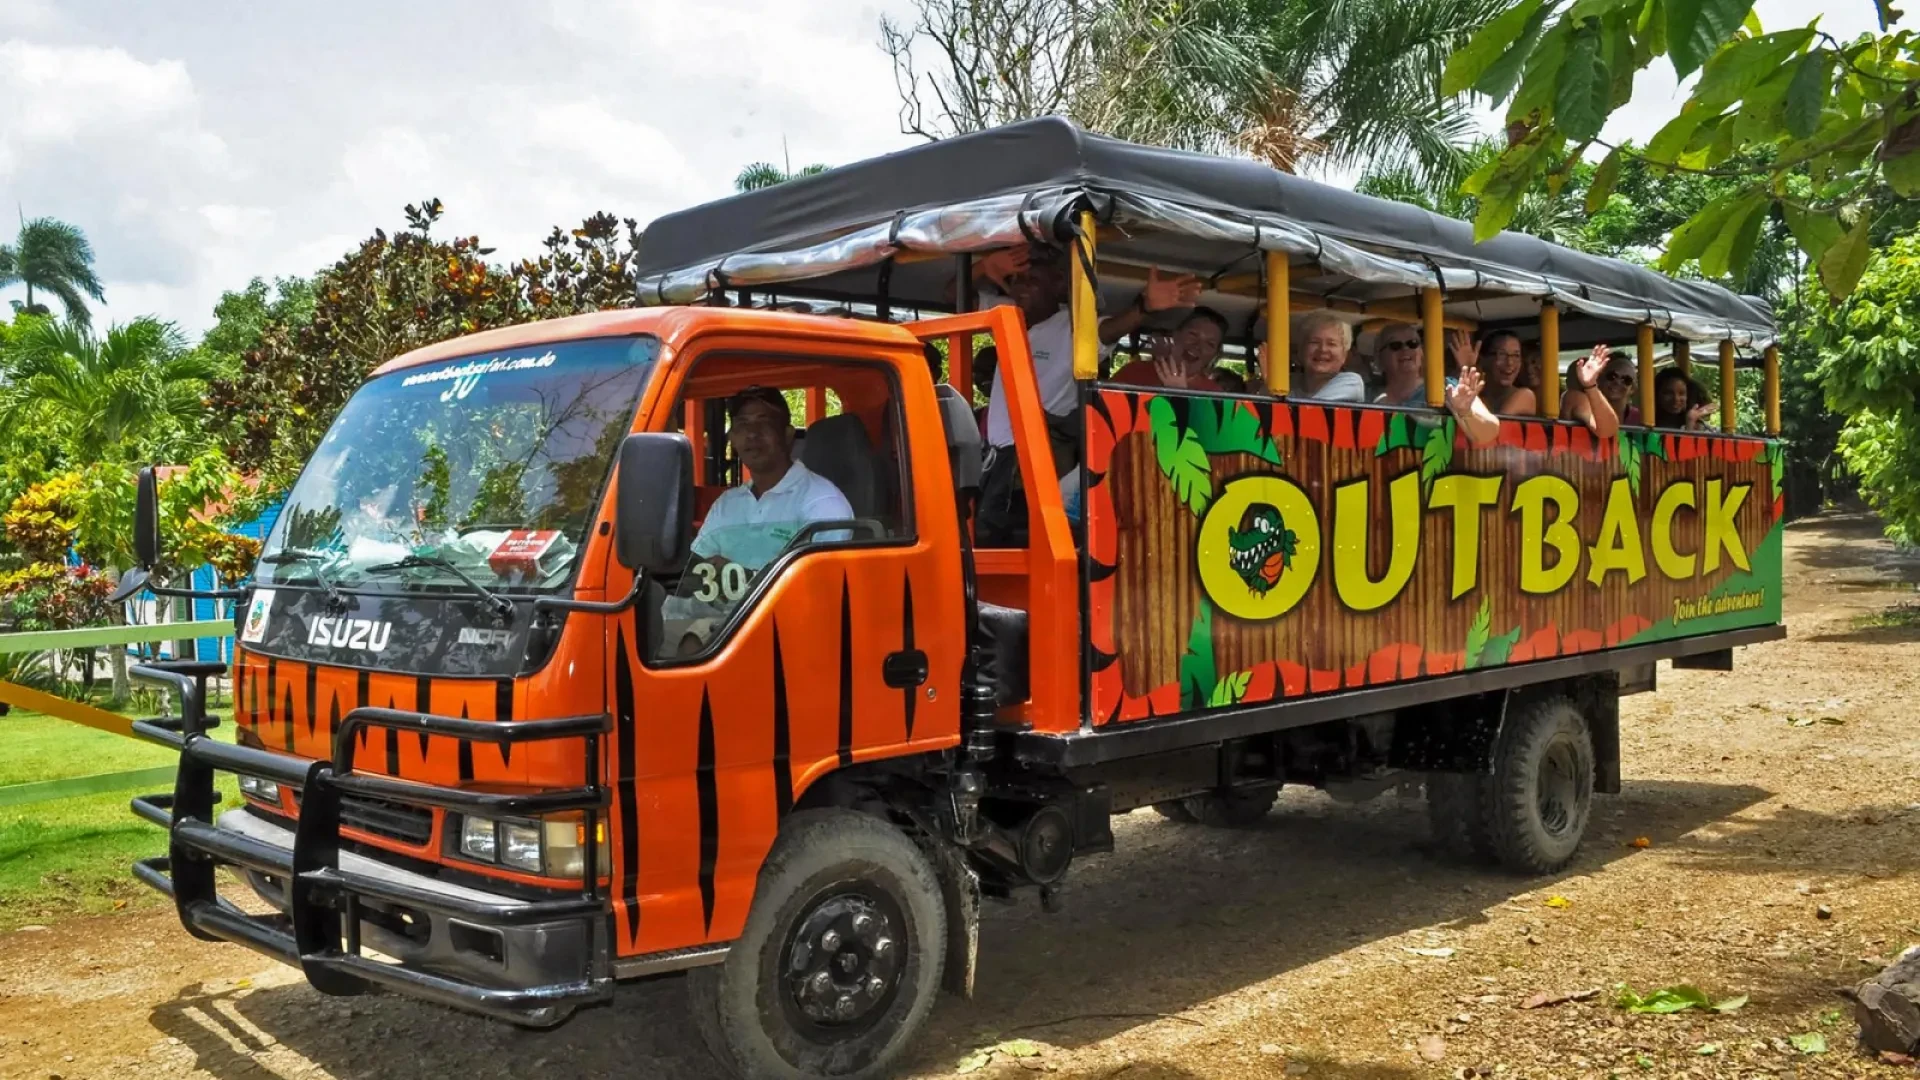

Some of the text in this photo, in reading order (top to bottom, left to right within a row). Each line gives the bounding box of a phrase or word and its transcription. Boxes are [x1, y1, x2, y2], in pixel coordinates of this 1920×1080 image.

[1197, 470, 1752, 620] OUTBACK
[692, 562, 746, 602] 30
[1673, 587, 1765, 627] Join the adventure!
[307, 615, 392, 652] ISUZU
